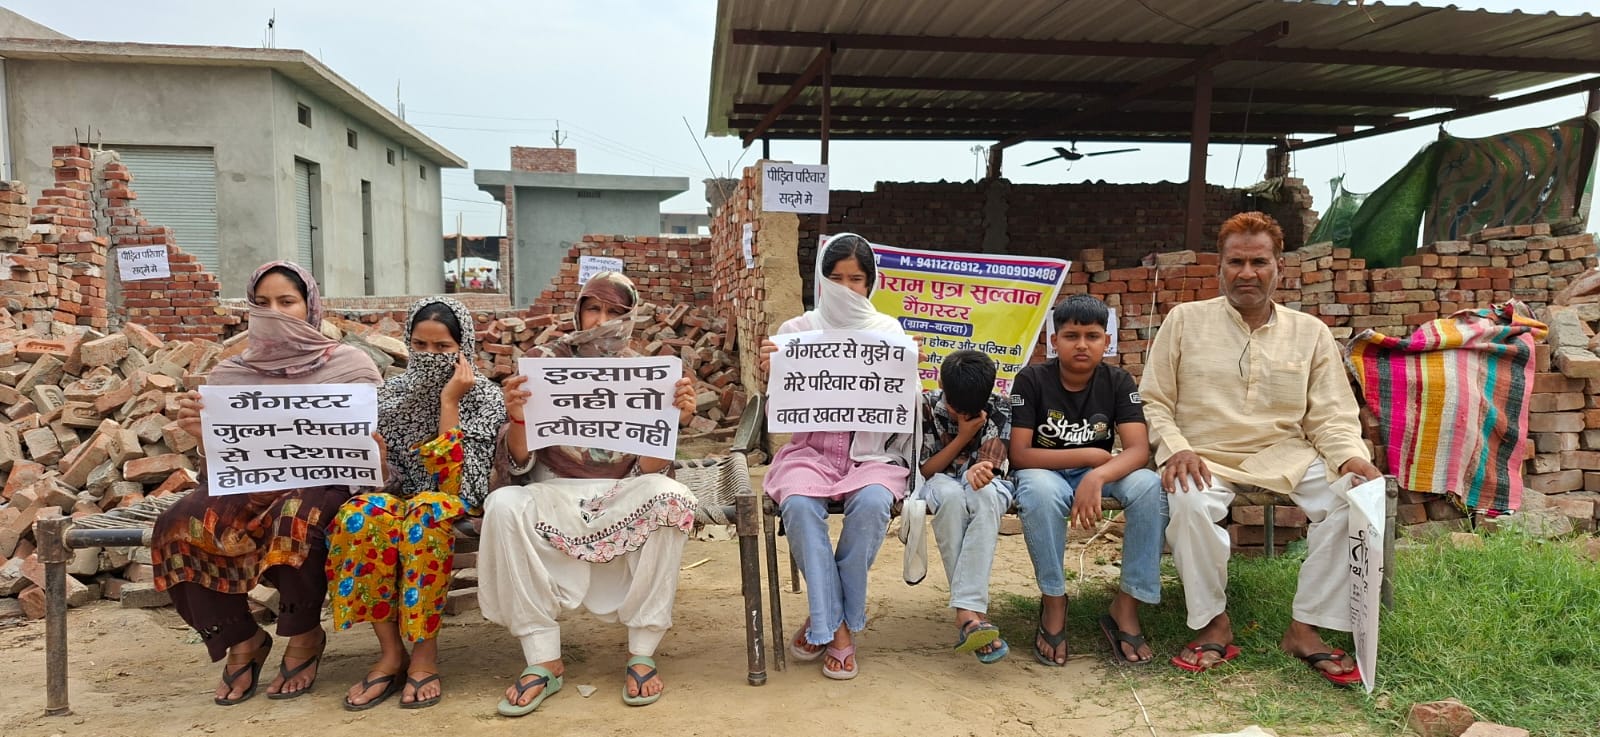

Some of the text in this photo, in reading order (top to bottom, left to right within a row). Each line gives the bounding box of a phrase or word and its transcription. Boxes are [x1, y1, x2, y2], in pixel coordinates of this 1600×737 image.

[767, 167, 826, 185] पीड़ित परिवार
[804, 191, 813, 205] मे
[900, 255, 913, 266] M.
[916, 257, 983, 275] 9411276912,
[986, 263, 1057, 281] 7080909488
[878, 272, 1043, 306] ीराम पुत्र सुल्तान
[903, 295, 972, 320] गैंगस्टर
[785, 338, 906, 365] गैंगस्टर से मुझे व
[929, 336, 956, 349] होकर
[979, 341, 1007, 354] पलिस
[1009, 344, 1022, 356] की
[542, 365, 670, 385] इन्साफ
[783, 369, 905, 393] मेरे परिवार को हर
[229, 391, 352, 410] गैंगस्टर
[550, 387, 665, 410] नही तो
[777, 404, 909, 426] वक्त खतरा रहता है
[212, 419, 372, 444] जुल्म-सितम
[535, 415, 671, 447] त्यौहार नही
[217, 444, 370, 463] से परेशान
[217, 466, 377, 488] होकर पलायन
